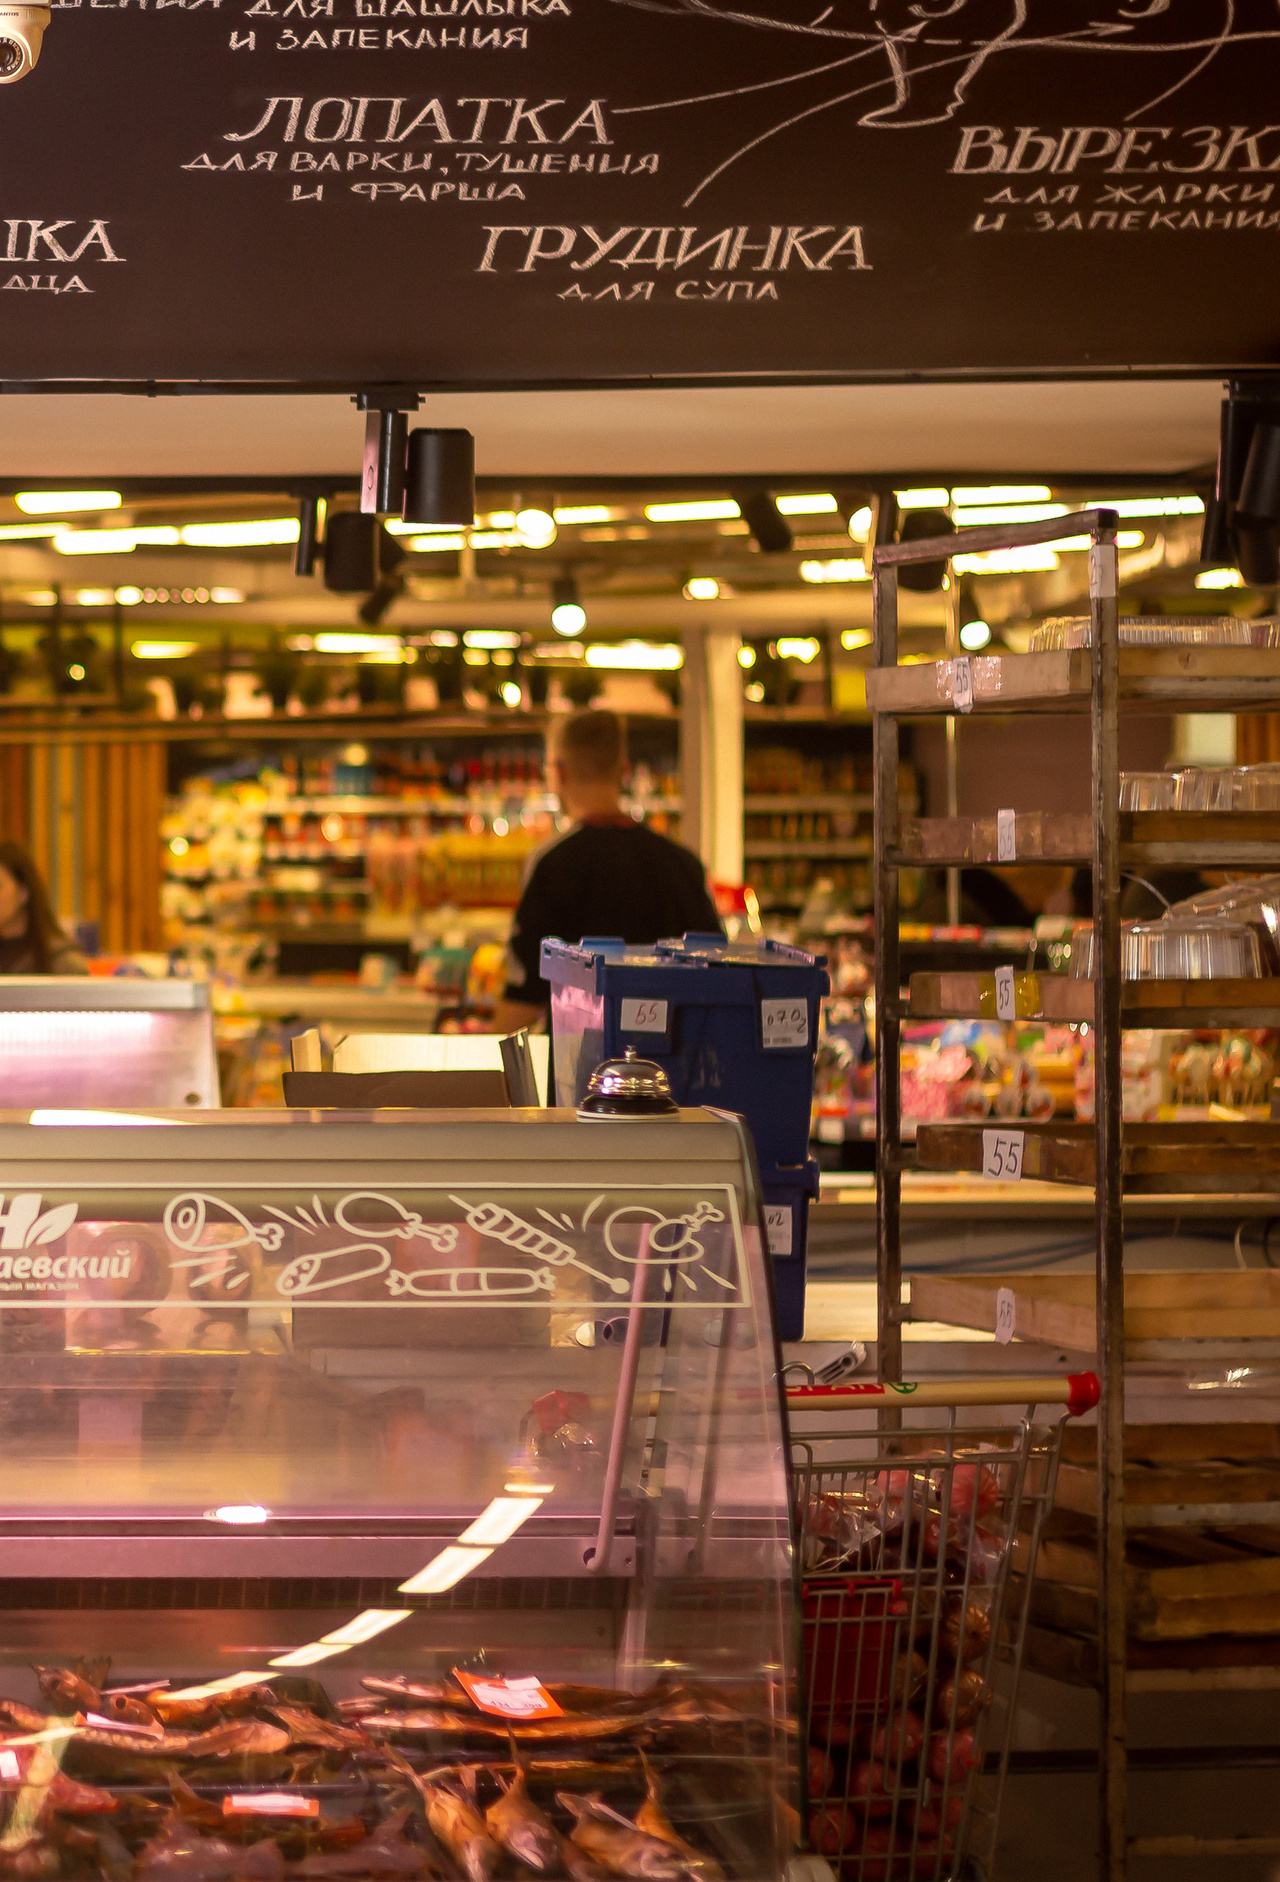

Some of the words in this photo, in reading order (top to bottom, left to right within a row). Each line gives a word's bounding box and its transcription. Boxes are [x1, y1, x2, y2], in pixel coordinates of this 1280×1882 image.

[244, 0, 333, 18] ДЛЯ
[356, 0, 571, 17] ШАШЛЫКА
[229, 30, 256, 50] И
[276, 27, 528, 50] ЗАПЕКАНИЯ
[223, 96, 615, 145] ЛОПАТКА
[181, 151, 278, 171] ДЛЯ
[289, 151, 449, 176] ВАРКИ,
[455, 152, 660, 174] ТУШЕНИЯ
[292, 184, 324, 201] И
[350, 181, 526, 202] ФАРША
[983, 184, 1080, 204] ДЛЯ
[1095, 183, 1275, 204] ЖАРКИ
[973, 212, 1007, 232] И
[474, 224, 873, 273] ГРУДИНКА
[556, 280, 656, 301] ДЛЯ
[674, 280, 779, 301] СУПА
[987, 1136, 1020, 1176] 55
[25, 1282, 79, 1291] МАГАЗИН
